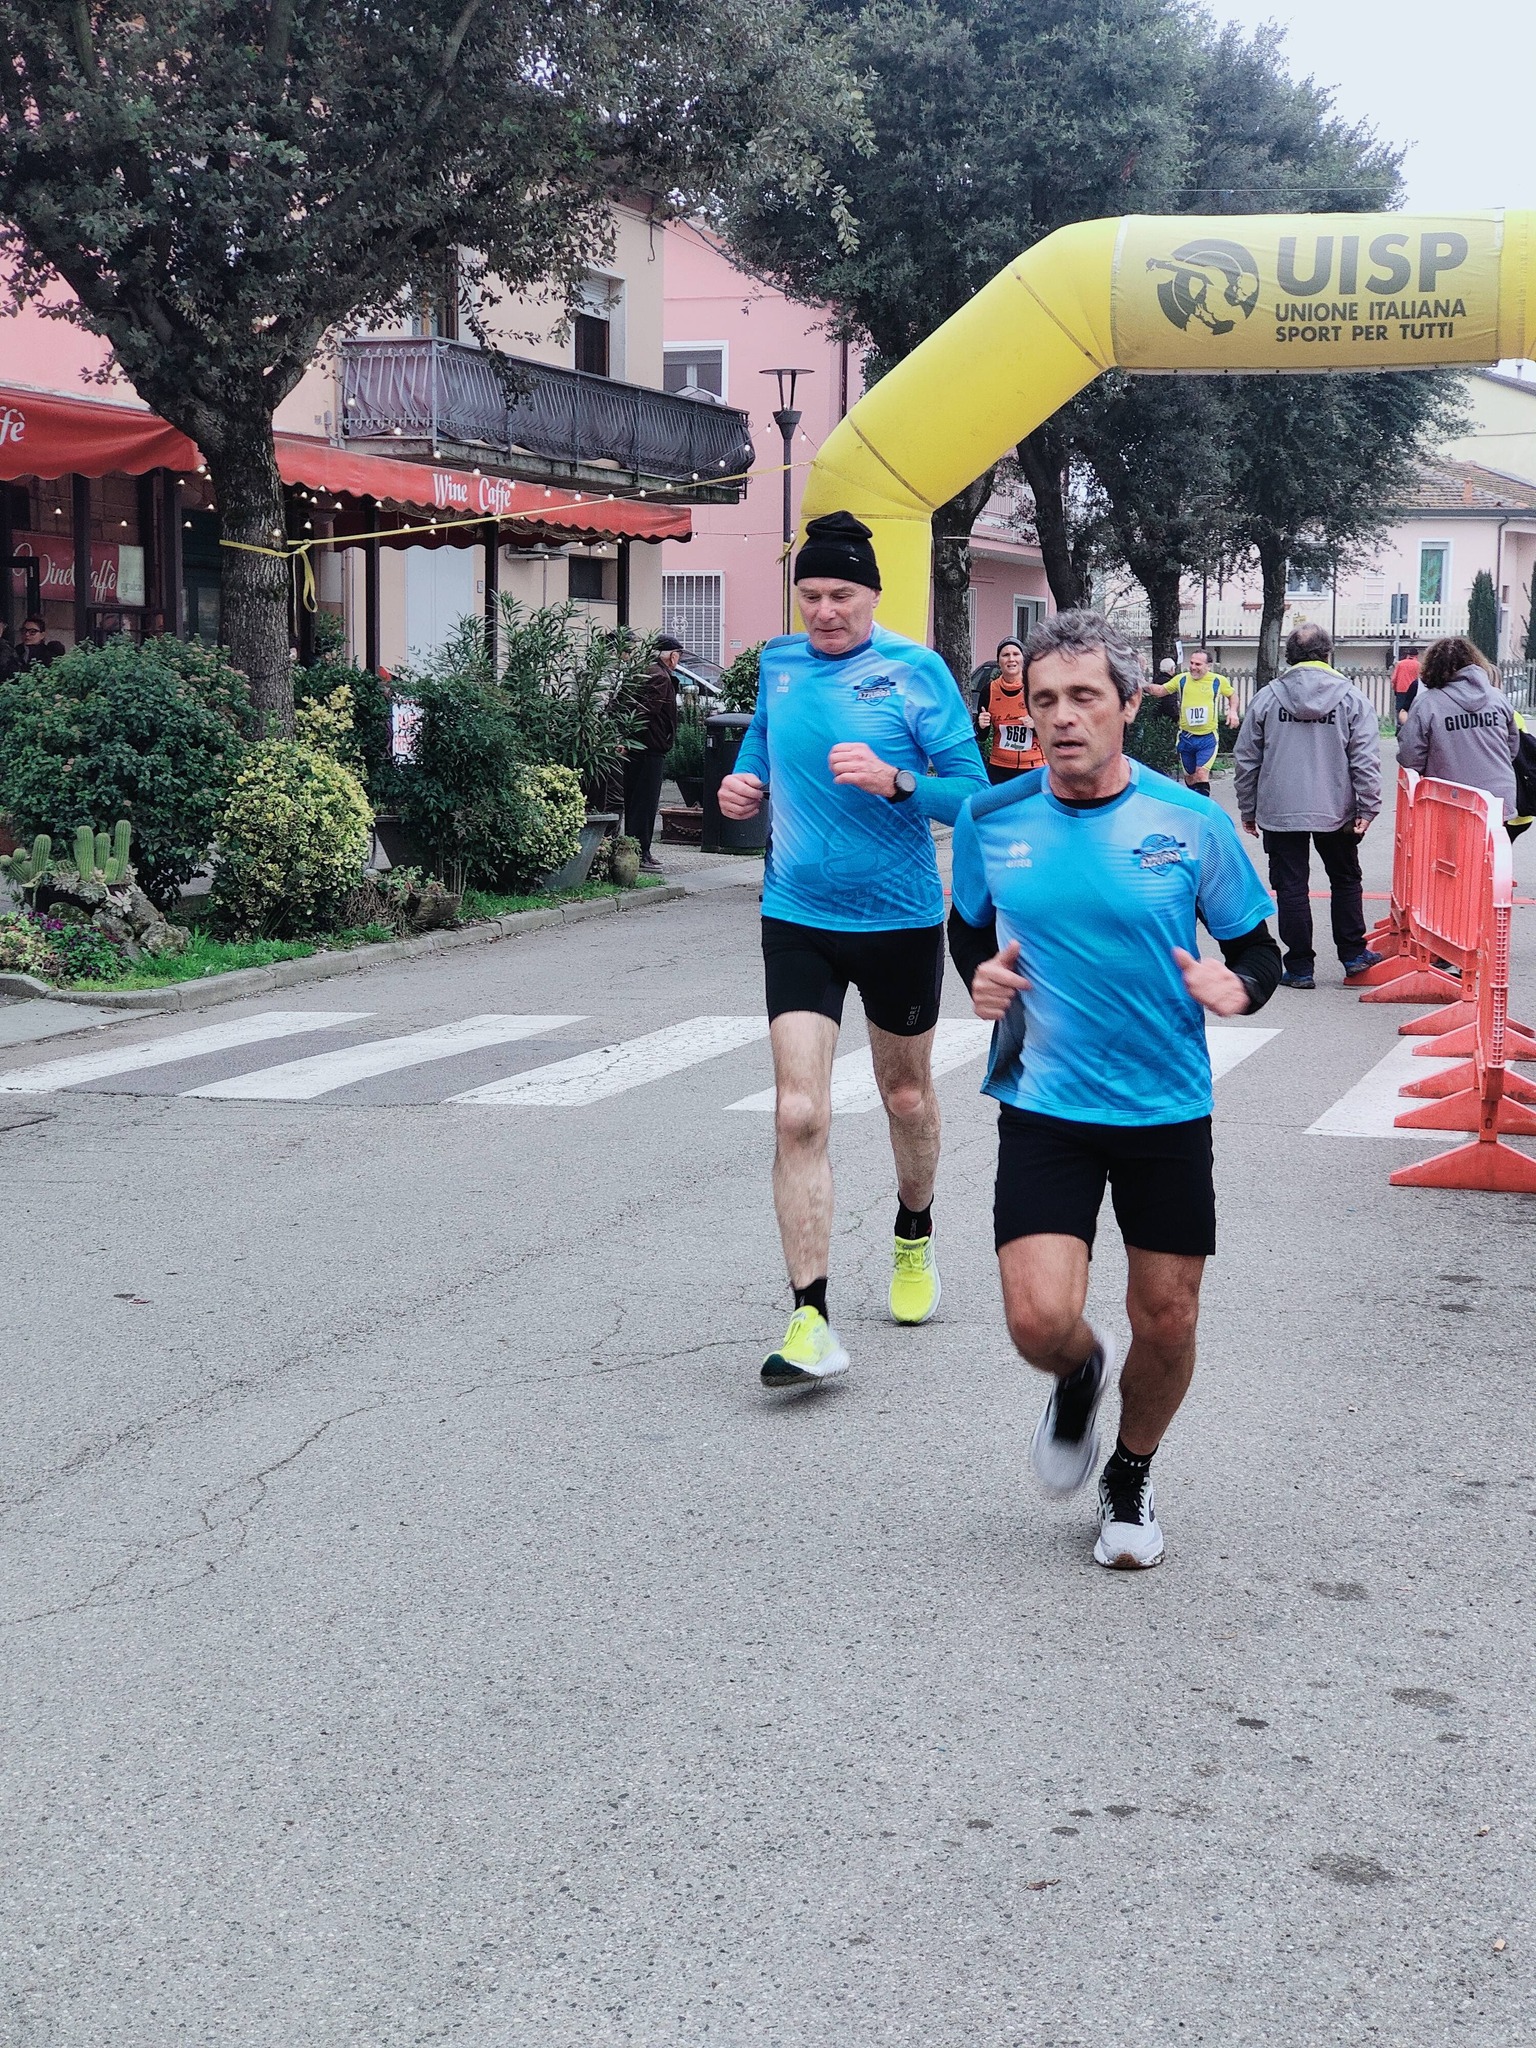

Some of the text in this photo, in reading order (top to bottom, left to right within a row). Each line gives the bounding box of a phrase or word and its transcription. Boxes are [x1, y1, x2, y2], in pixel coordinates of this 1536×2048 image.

[1276, 231, 1469, 297] UISP
[1275, 298, 1467, 322] UNIONE ITALIANA
[1275, 321, 1454, 343] SPORT PER TUTTI
[432, 473, 469, 507] Wine
[1444, 711, 1500, 732] GIUDICE
[1006, 725, 1028, 744] 668
